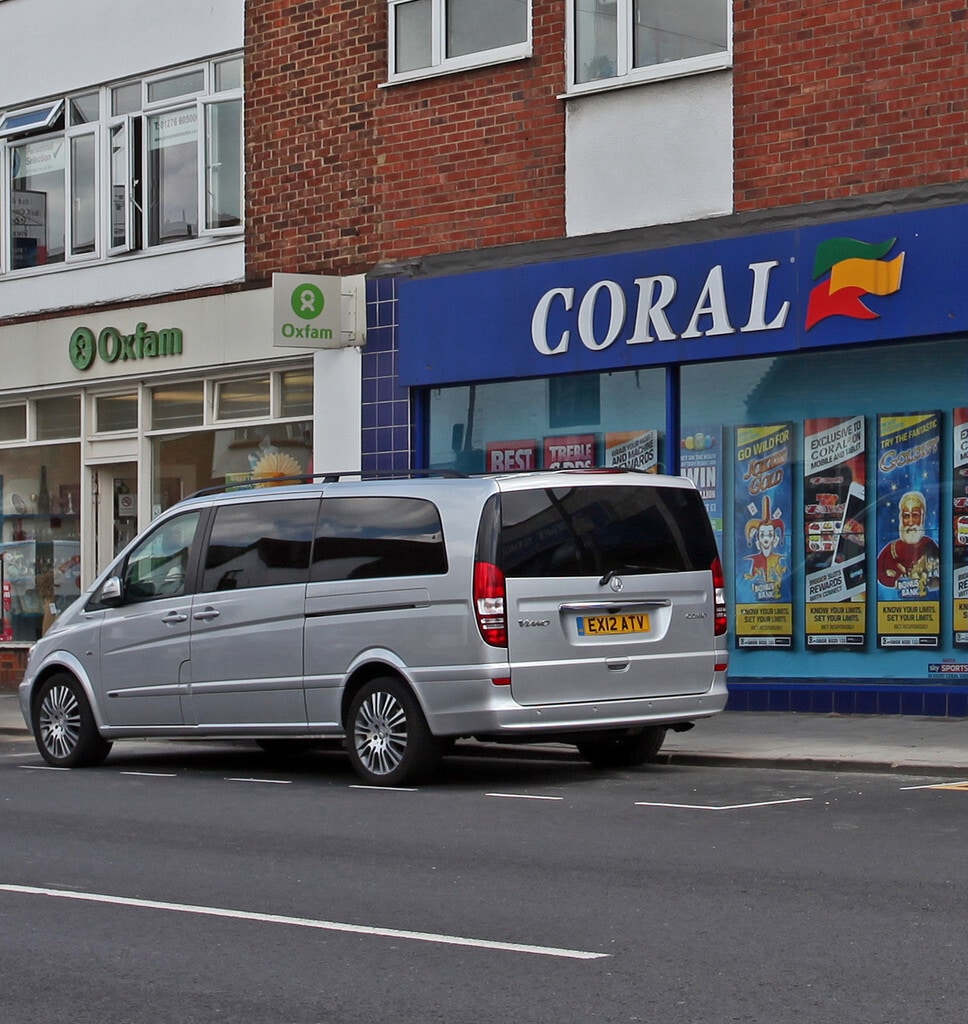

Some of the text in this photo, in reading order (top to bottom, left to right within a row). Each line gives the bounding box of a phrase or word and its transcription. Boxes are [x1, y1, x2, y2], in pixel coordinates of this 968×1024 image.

[531, 260, 791, 355] CORAL
[98, 322, 183, 362] Oxfam
[281, 323, 333, 340] Oxfam
[737, 447, 751, 461] GO
[753, 437, 775, 455] WILD
[775, 429, 789, 445] FOR
[811, 421, 861, 450] EXCLUSIVE TO
[811, 432, 861, 460] CORAL ON
[881, 438, 894, 449] TRY
[895, 433, 907, 444] THE
[908, 419, 938, 439] FANTASTIC
[491, 449, 532, 471] BEST
[549, 443, 592, 461] TREBLE
[612, 439, 654, 466] AND MACHINE
[613, 448, 654, 469] EWARDS
[810, 443, 861, 470] MOBILE AND TABLET
[809, 577, 842, 595] REWARDS
[587, 616, 643, 633] EX12 ATV
[941, 664, 968, 672] SPORTS
